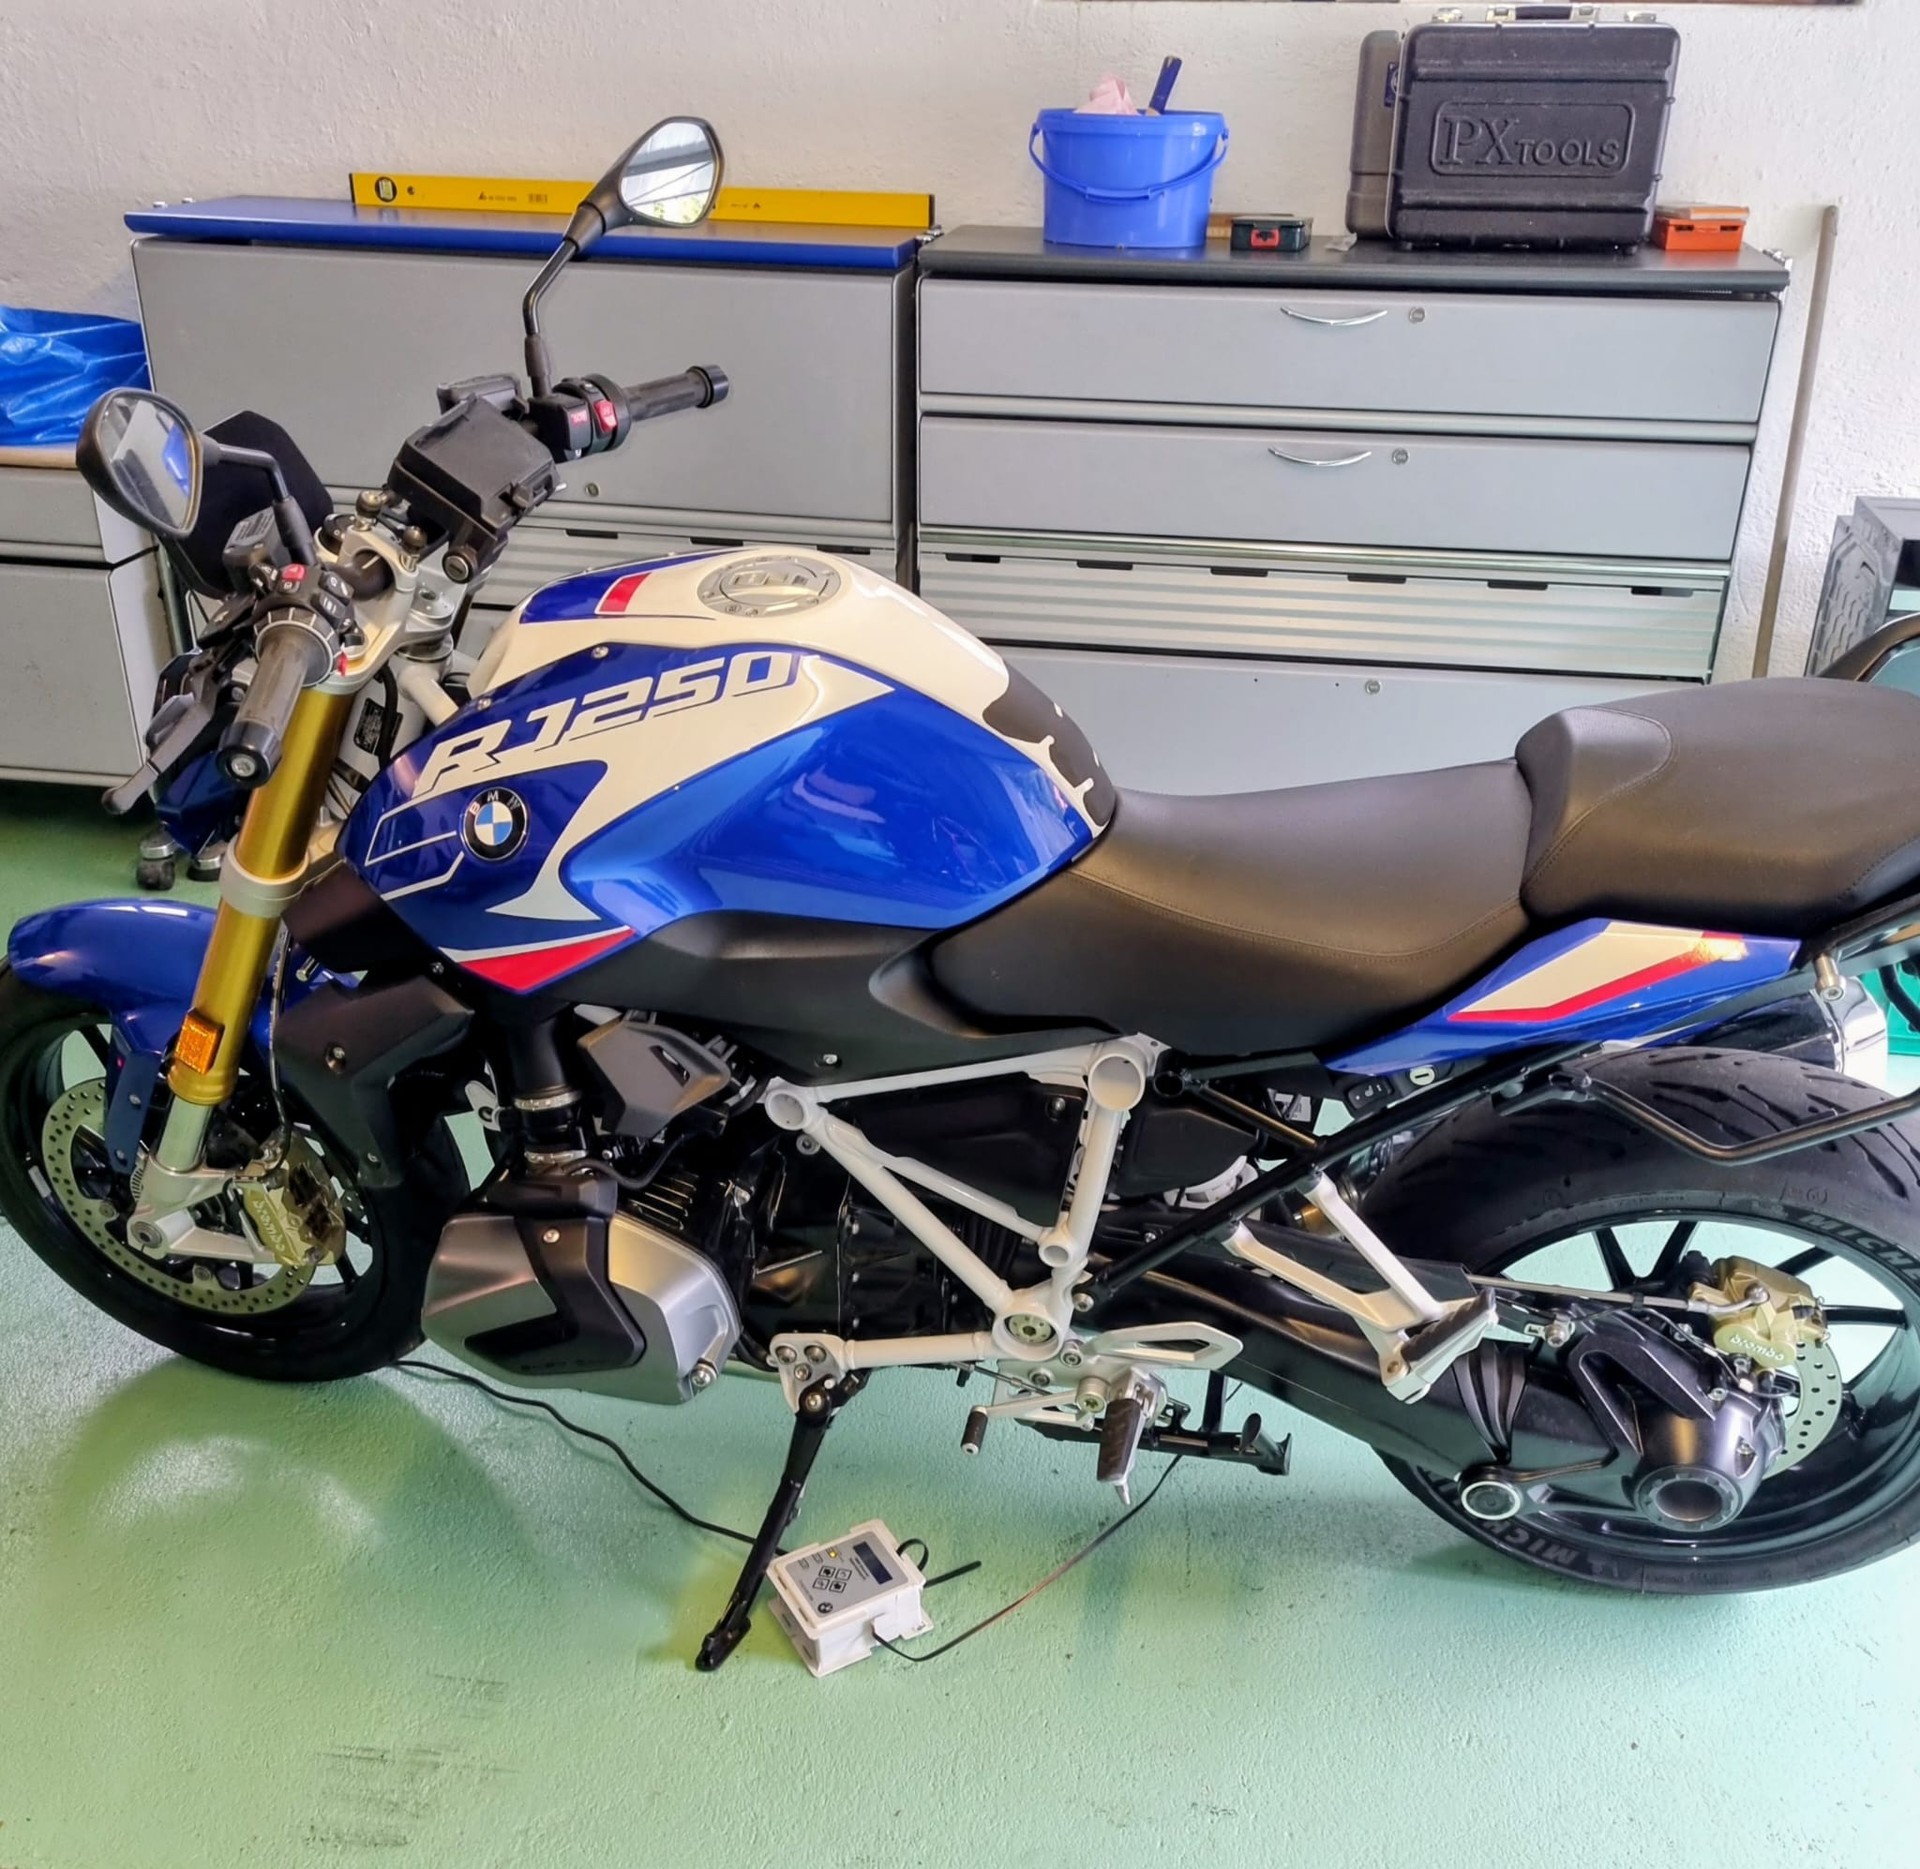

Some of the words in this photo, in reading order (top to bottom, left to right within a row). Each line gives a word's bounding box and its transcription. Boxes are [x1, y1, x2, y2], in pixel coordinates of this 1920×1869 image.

[468, 789, 521, 816] BMW
[252, 1199, 286, 1252] brembo
[1729, 1333, 1785, 1361] brembo
[1481, 1518, 1580, 1565] MICH
